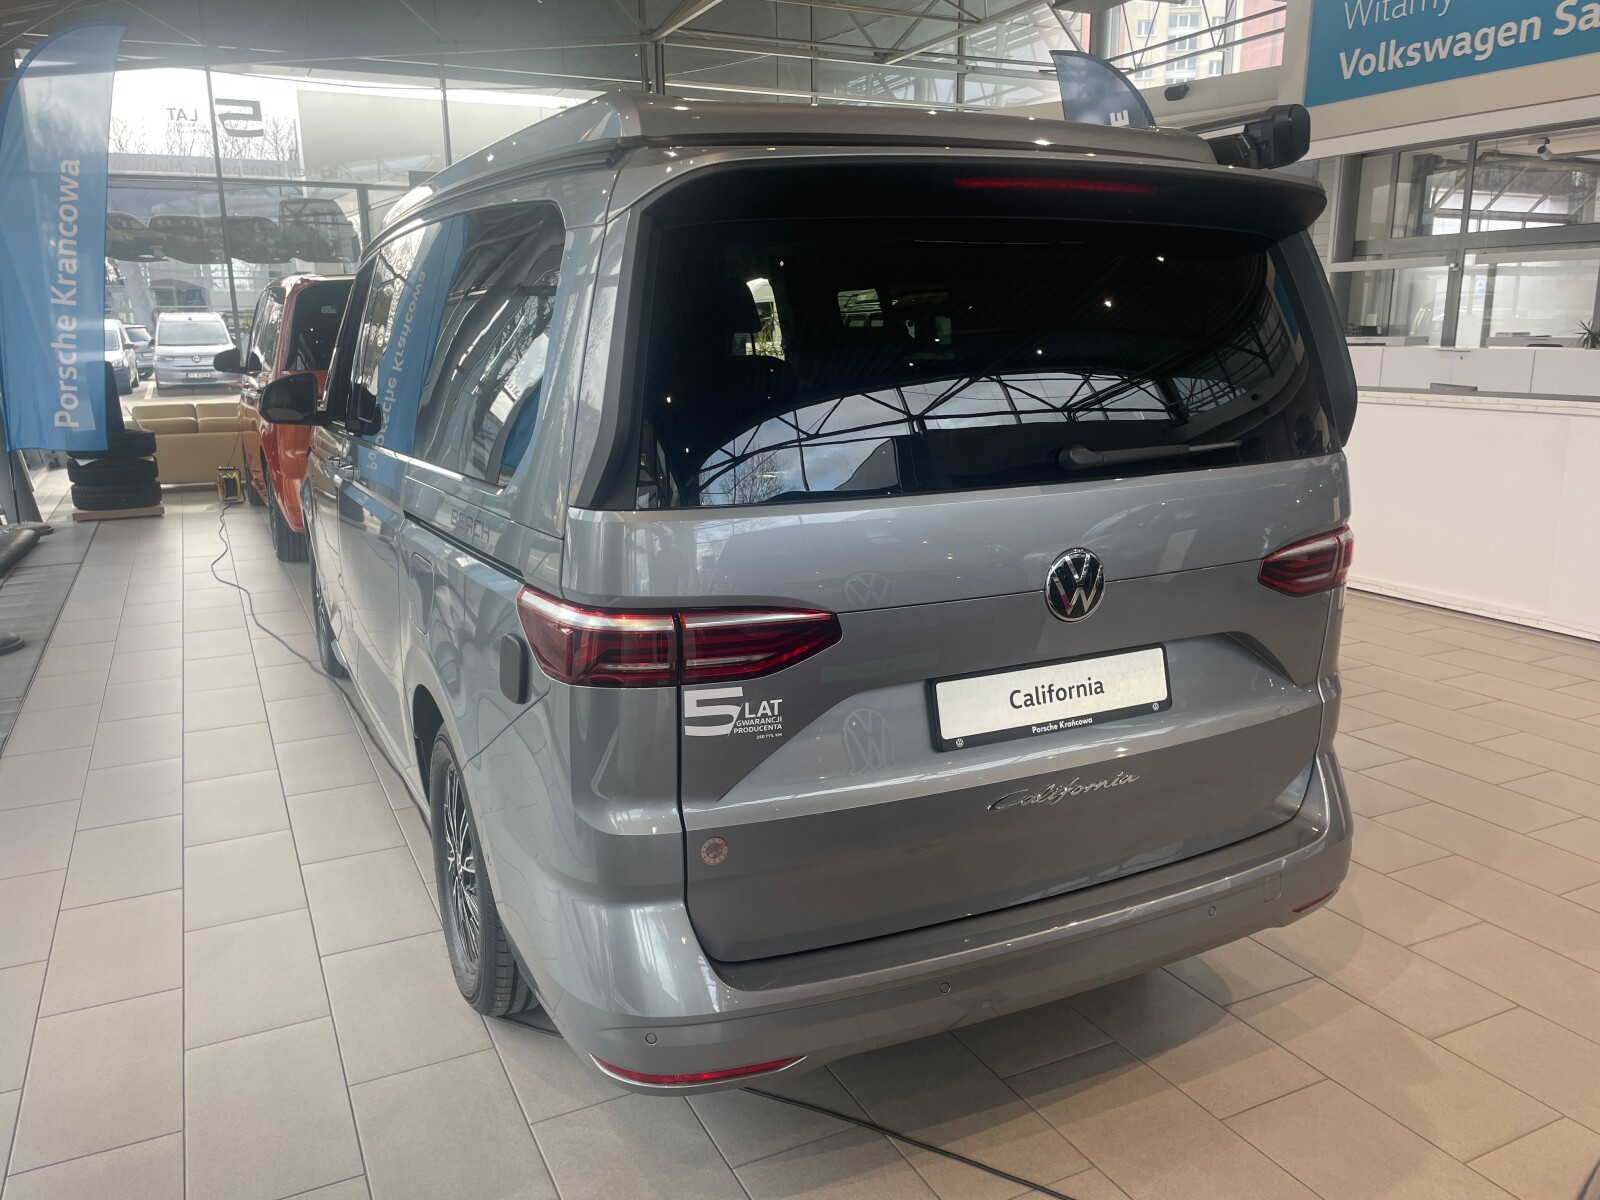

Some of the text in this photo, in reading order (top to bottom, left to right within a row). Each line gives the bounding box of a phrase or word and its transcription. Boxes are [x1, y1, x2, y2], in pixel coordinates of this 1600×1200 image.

[1339, 16, 1541, 80] Volkswagen
[49, 160, 80, 428] Porsche Krańcowa
[684, 686, 783, 737] 5 LAT
[1009, 676, 1105, 710] California
[733, 723, 783, 734] PRODUCENTA
[736, 716, 783, 727] GWARANCJI
[1031, 717, 1093, 734] Porsche Krańcowa
[987, 771, 1140, 812] California
